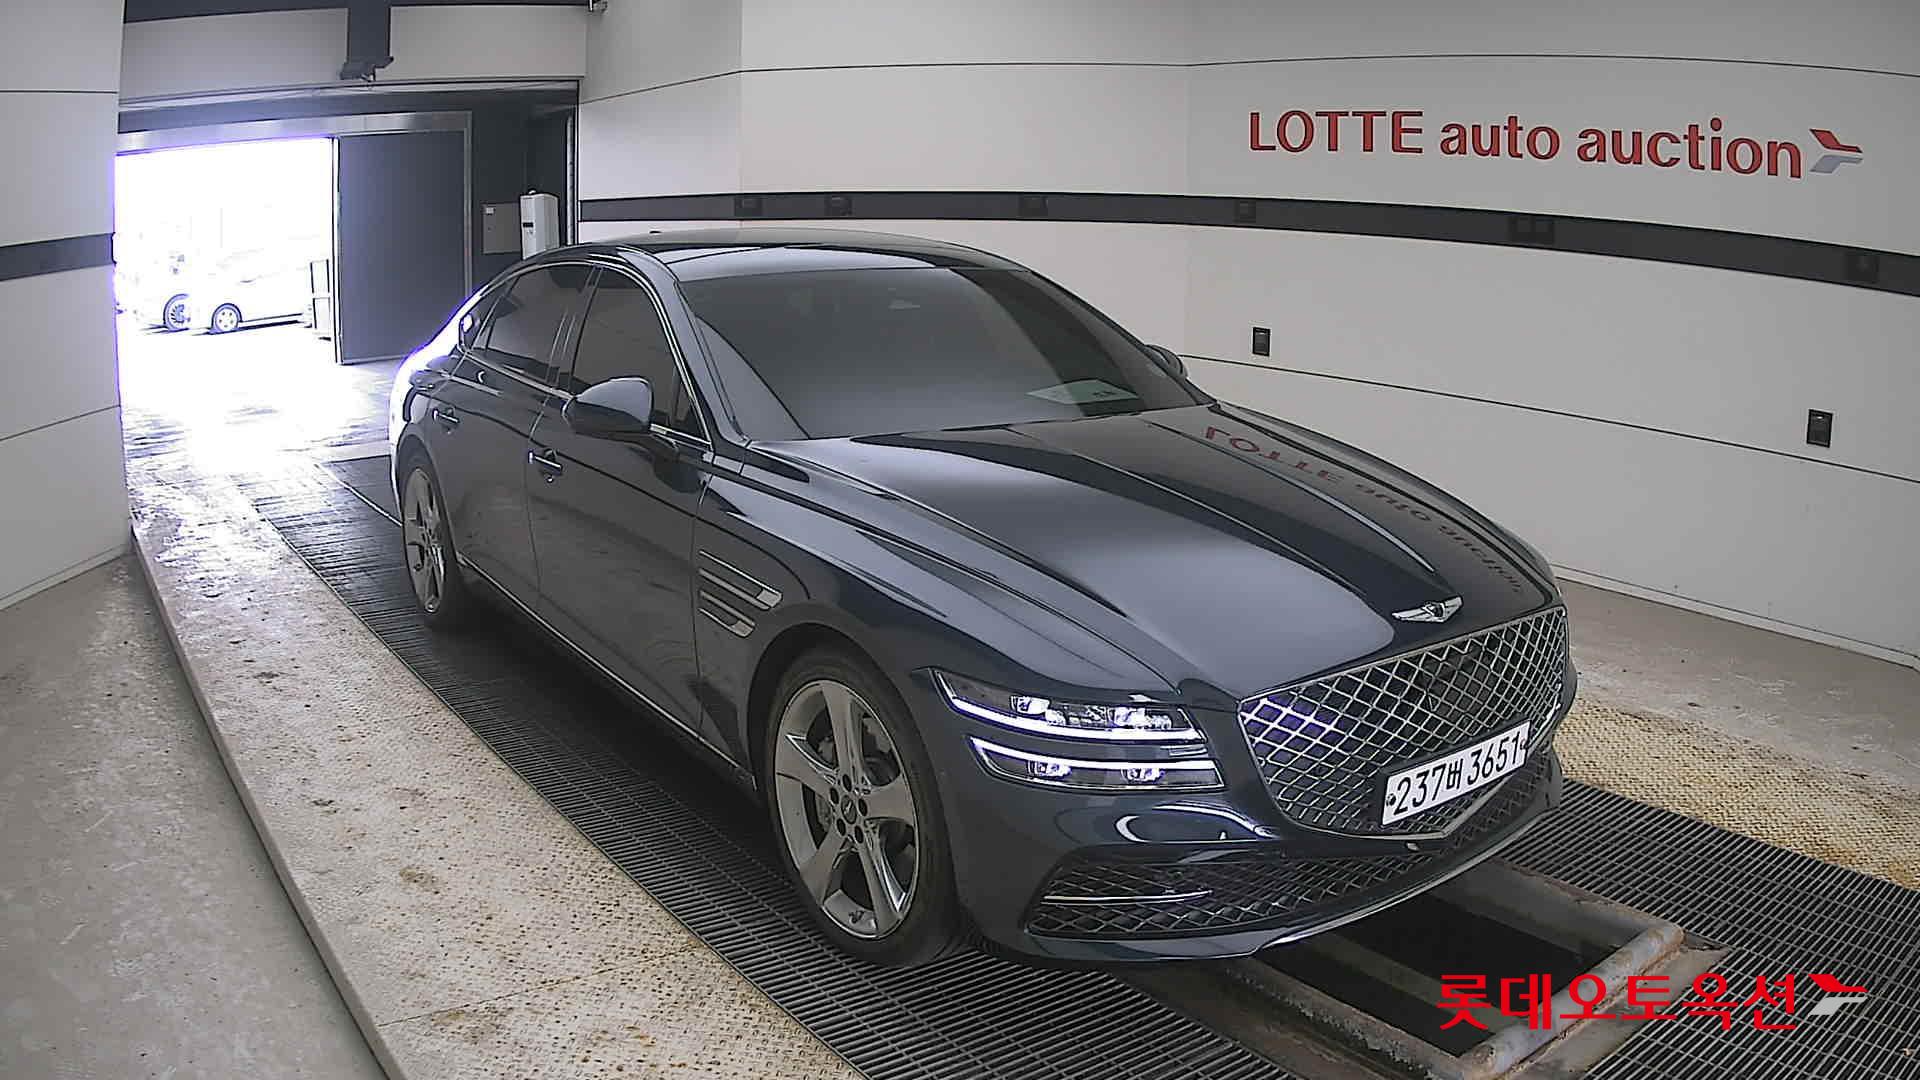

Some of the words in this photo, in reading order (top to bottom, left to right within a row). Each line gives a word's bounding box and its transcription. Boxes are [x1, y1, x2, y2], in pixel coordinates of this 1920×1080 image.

[1249, 110, 1425, 154] LOTTE
[1439, 114, 1561, 160] auto
[1576, 117, 1803, 180] auction
[1393, 758, 1464, 815] 237버
[1467, 731, 1520, 786] 3651
